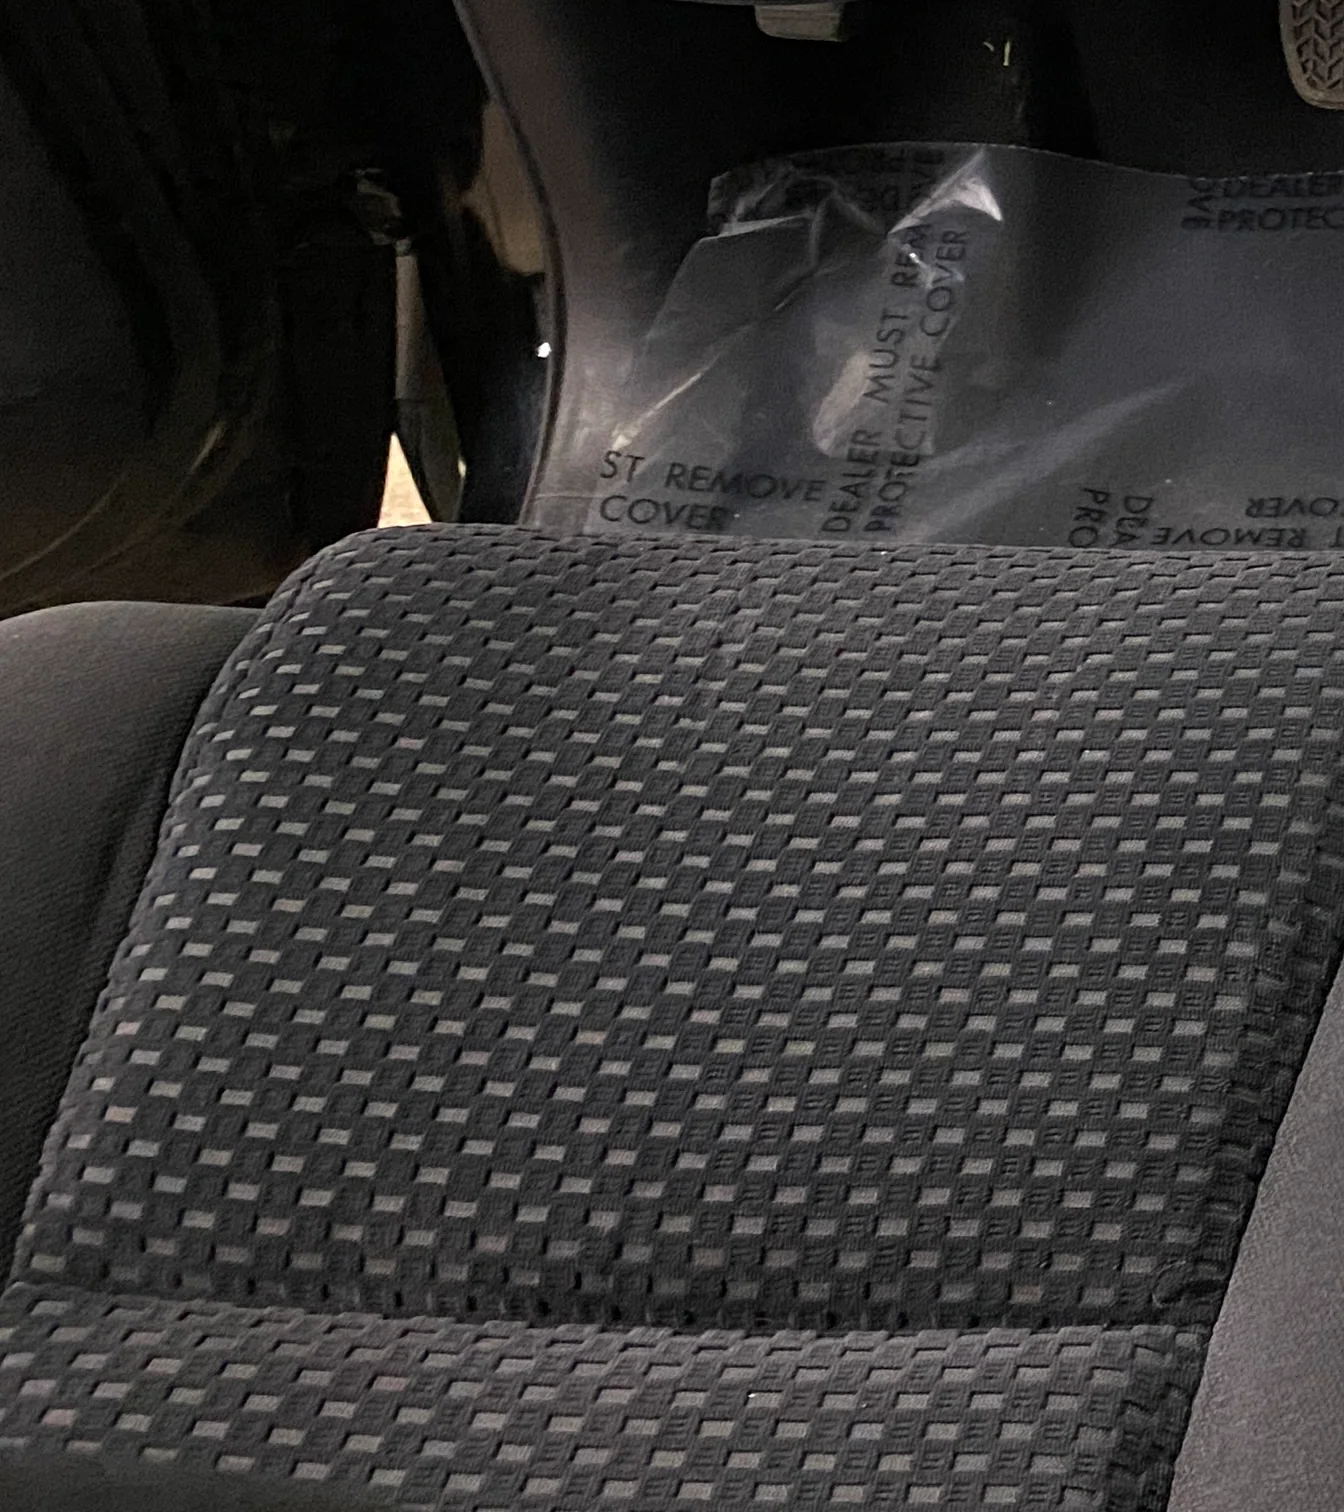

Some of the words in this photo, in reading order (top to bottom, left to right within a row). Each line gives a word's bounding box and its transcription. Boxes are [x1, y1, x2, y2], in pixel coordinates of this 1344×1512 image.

[1220, 171, 1344, 200] DEALER
[864, 350, 946, 533] PROTECTIVE
[920, 230, 971, 338] COVER
[820, 427, 882, 534] DEALER
[864, 309, 910, 403] MUST
[599, 449, 646, 484] ST
[663, 461, 827, 502] REMOVE
[598, 492, 733, 531] COVER
[1149, 524, 1308, 549] REMOVE
